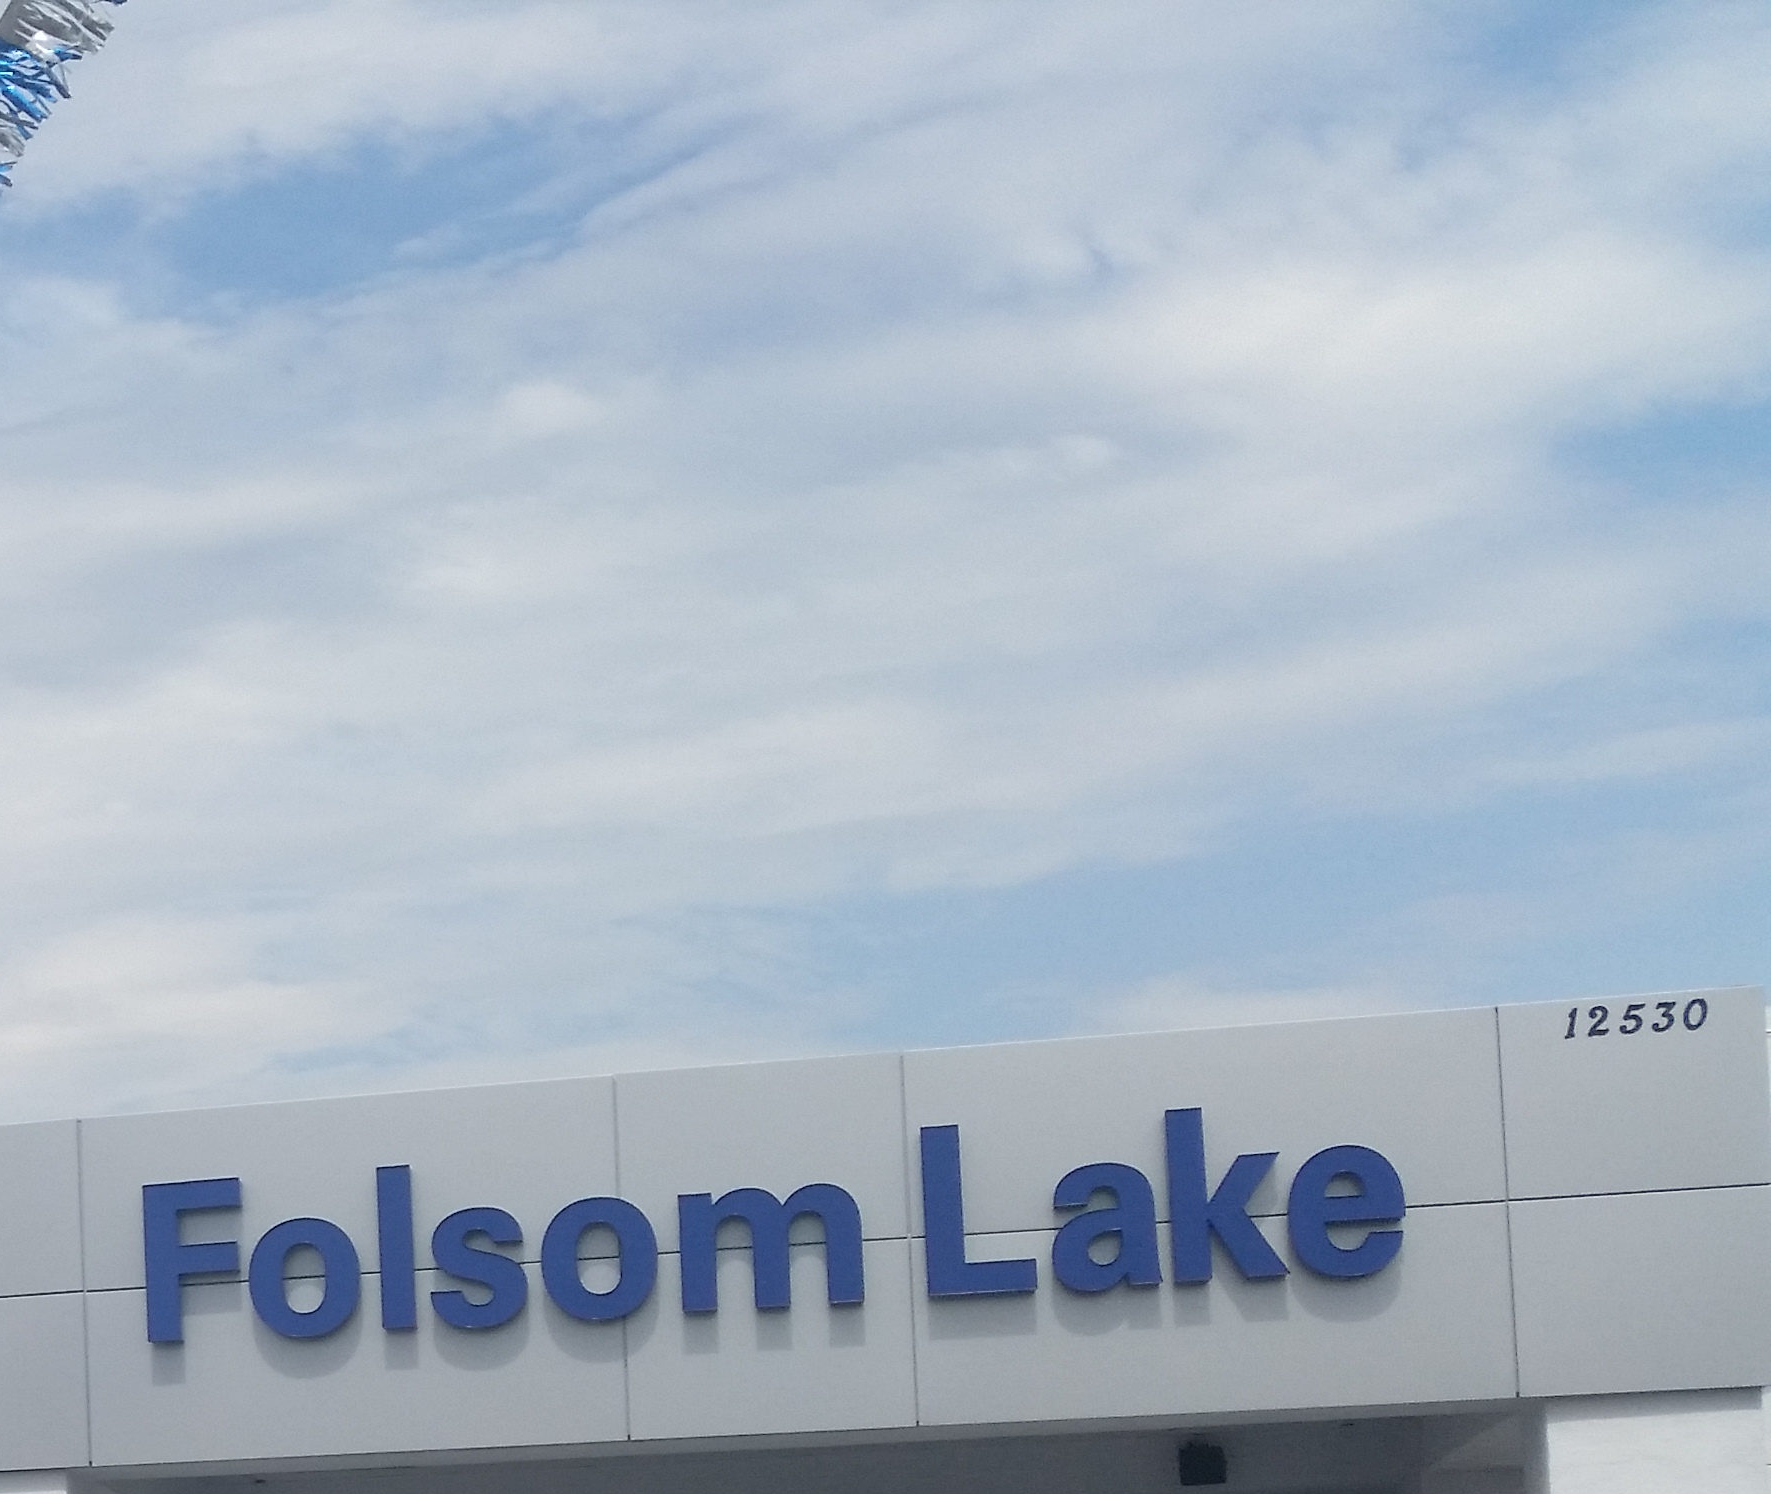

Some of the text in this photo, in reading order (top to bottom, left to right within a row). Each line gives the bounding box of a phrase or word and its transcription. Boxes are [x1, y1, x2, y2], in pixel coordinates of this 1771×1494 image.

[1564, 998, 1708, 1040] 12530
[141, 1106, 1407, 1344] Folsom Lake
